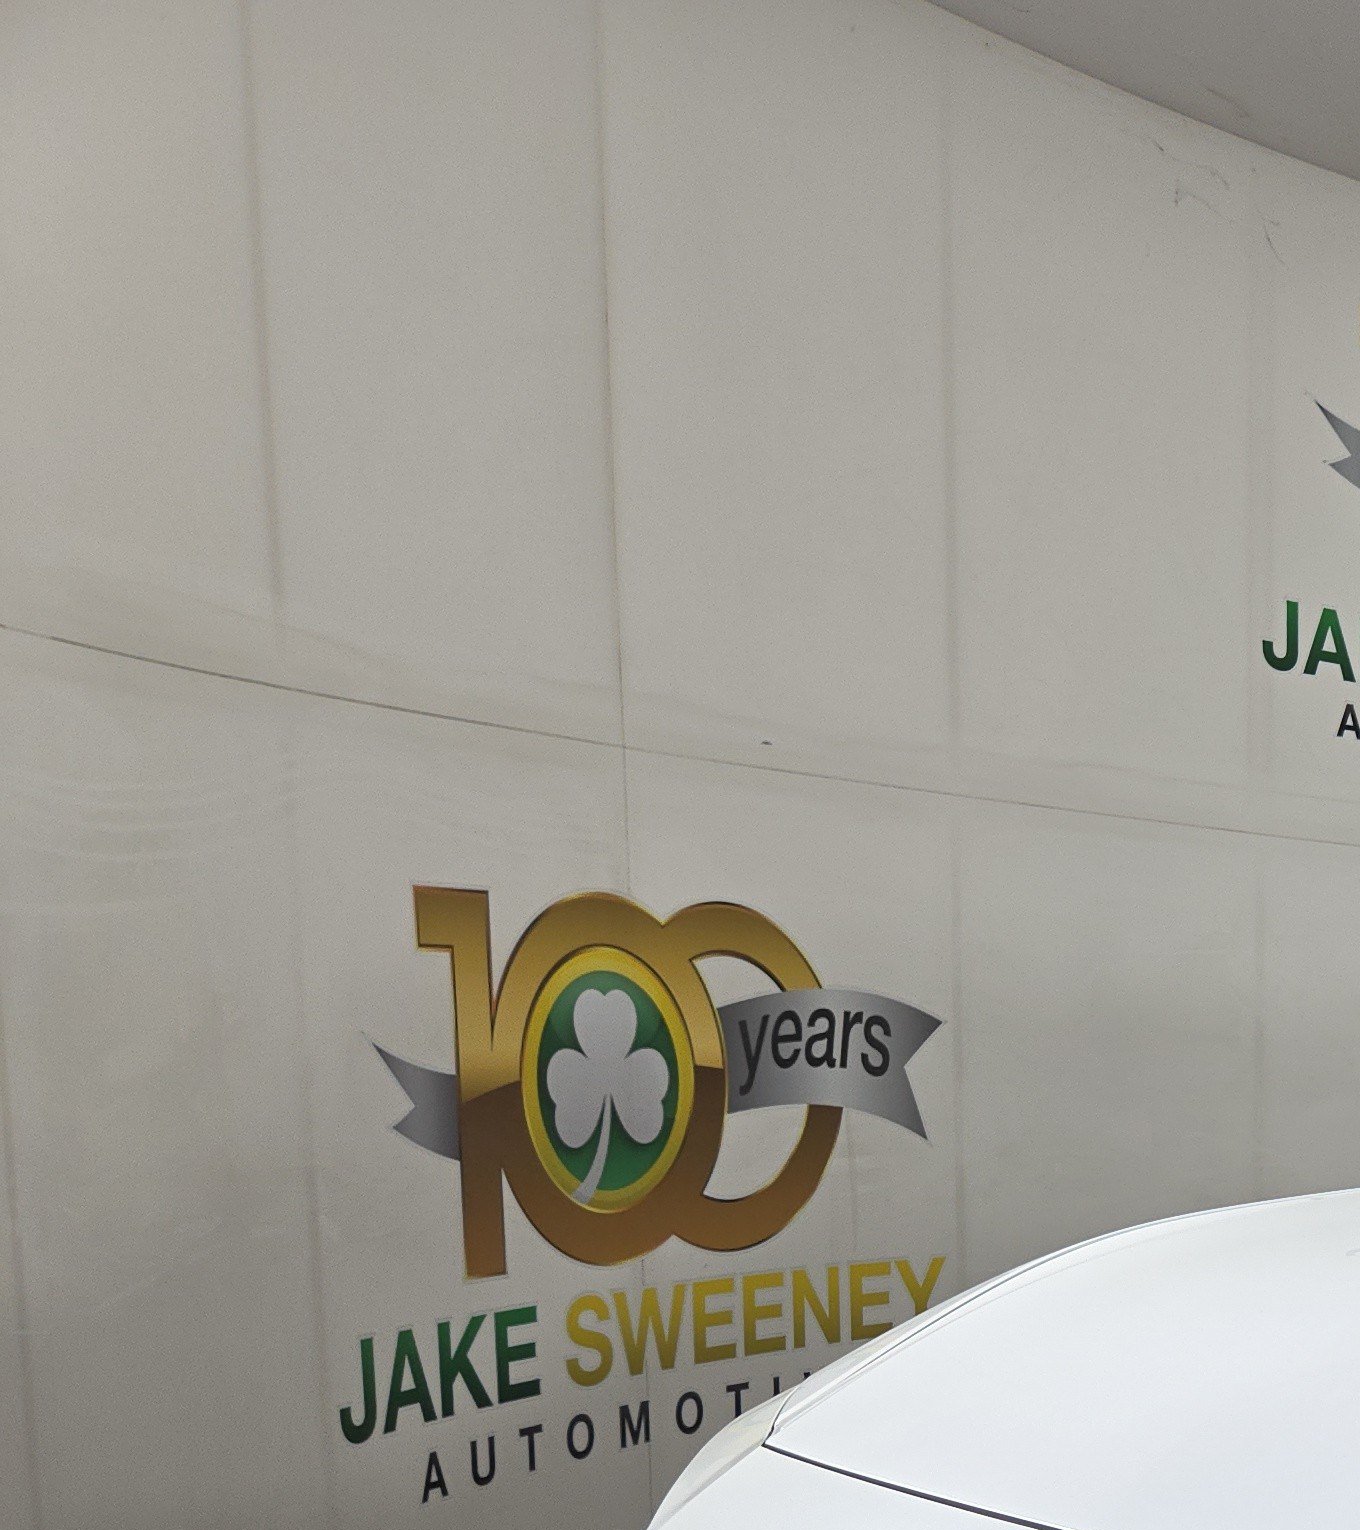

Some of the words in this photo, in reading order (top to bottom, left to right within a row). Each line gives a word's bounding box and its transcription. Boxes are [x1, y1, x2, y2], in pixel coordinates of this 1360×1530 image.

[738, 1008, 892, 1095] years
[339, 1305, 542, 1444] JAKE
[421, 1371, 811, 1503] AUTOMOT
